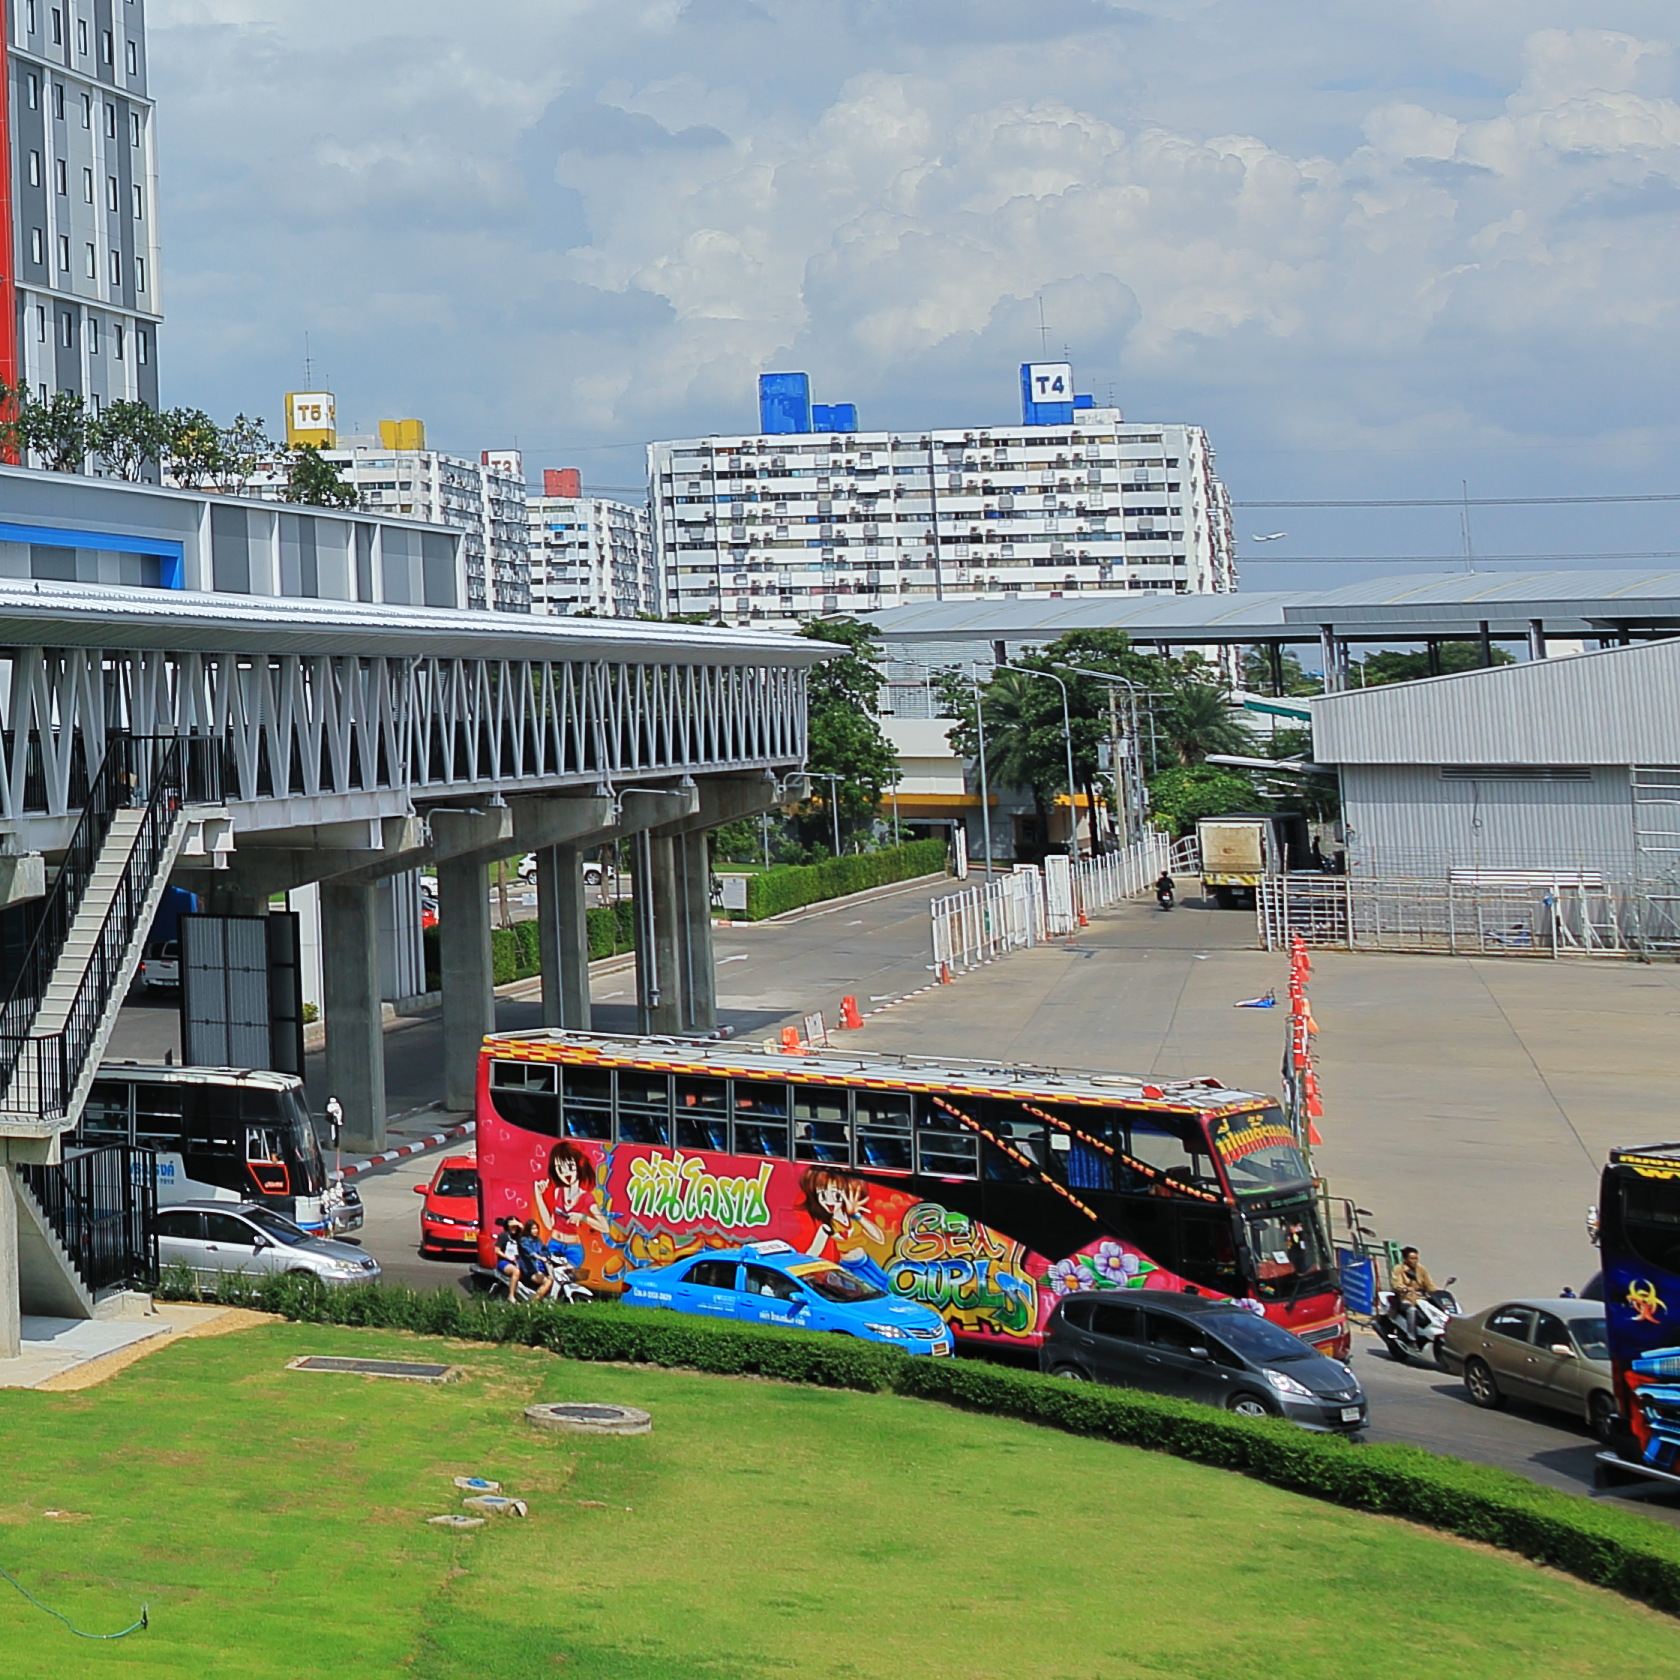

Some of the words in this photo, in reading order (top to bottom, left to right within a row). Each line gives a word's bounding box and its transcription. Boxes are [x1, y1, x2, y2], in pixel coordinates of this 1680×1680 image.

[297, 404, 322, 422] T5
[1035, 375, 1064, 395] T4
[1022, 1102, 1072, 1131] LONG
[1076, 1129, 1115, 1155] LIVE
[1121, 1154, 1155, 1178] THE
[1165, 1177, 1218, 1203] KING
[627, 1150, 774, 1229] ที่นี่โคราช
[1040, 1172, 1098, 1221] TOUR
[887, 1259, 1032, 1330] GIRLS
